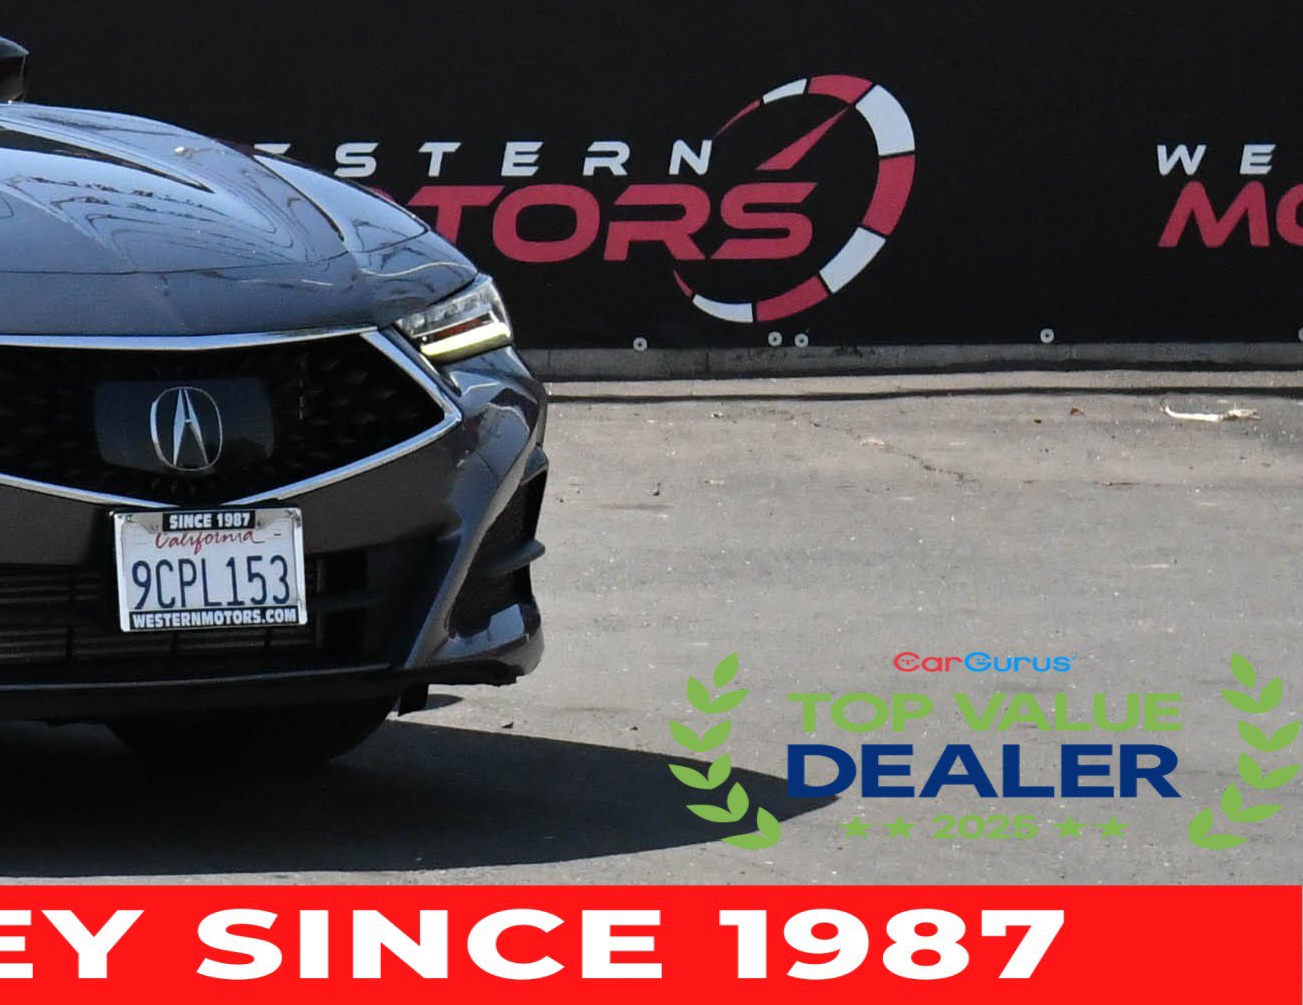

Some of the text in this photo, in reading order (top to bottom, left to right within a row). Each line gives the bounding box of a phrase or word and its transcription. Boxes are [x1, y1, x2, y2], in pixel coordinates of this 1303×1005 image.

[255, 140, 713, 178] STERN
[169, 512, 251, 530] SINCE 1987
[131, 554, 291, 611] 9CPL153
[132, 607, 298, 629] WESTERNMOTORS.COM
